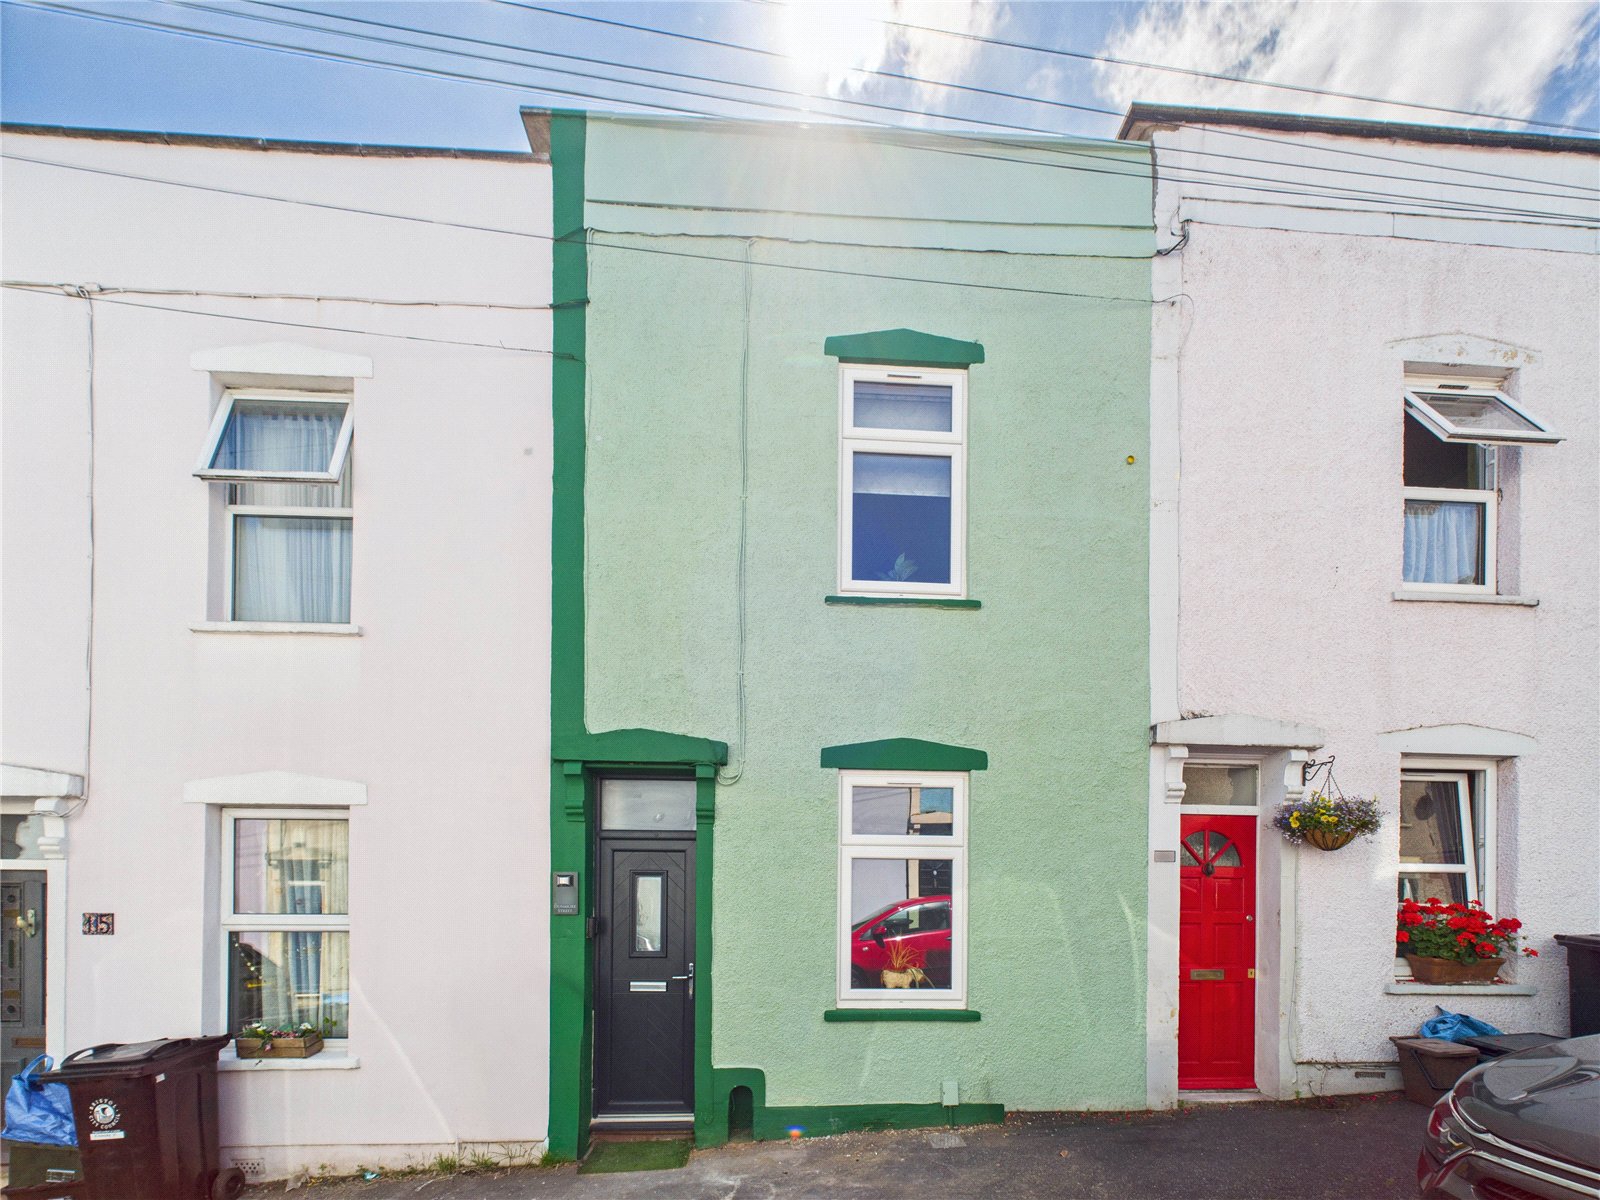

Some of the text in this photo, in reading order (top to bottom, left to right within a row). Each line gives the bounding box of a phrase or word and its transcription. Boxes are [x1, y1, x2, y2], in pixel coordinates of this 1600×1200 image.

[84, 914, 111, 934] 15
[88, 1098, 117, 1110] BRISTOL
[88, 1113, 121, 1129] CITY COUNCIL
